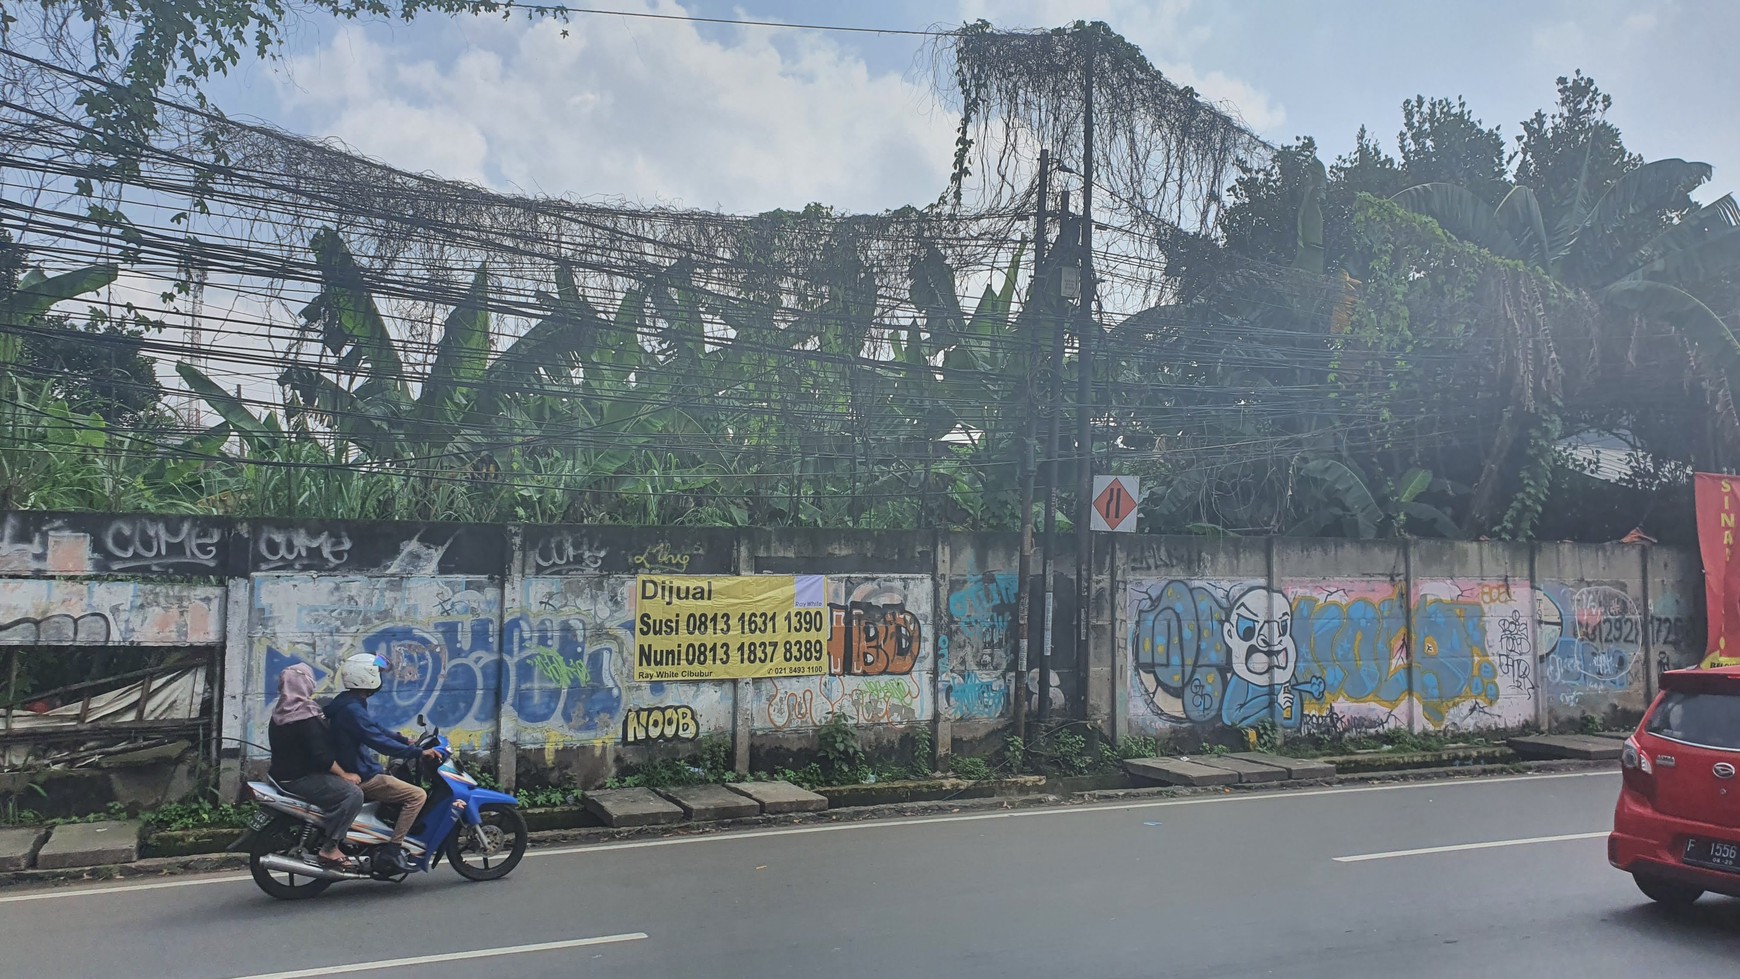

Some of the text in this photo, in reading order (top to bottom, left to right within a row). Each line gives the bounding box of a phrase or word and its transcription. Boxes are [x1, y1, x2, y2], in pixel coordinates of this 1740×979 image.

[641, 579, 713, 606] Dijual
[639, 610, 824, 636] Susi 0813 1631 1390
[638, 639, 823, 667] Nuni 0813 1837 8389
[638, 671, 654, 680] Ray
[681, 670, 713, 678] Cibubur
[775, 666, 823, 675] 021 8493 1100
[624, 705, 700, 745] NOOB
[1687, 838, 1737, 858] F 1556
